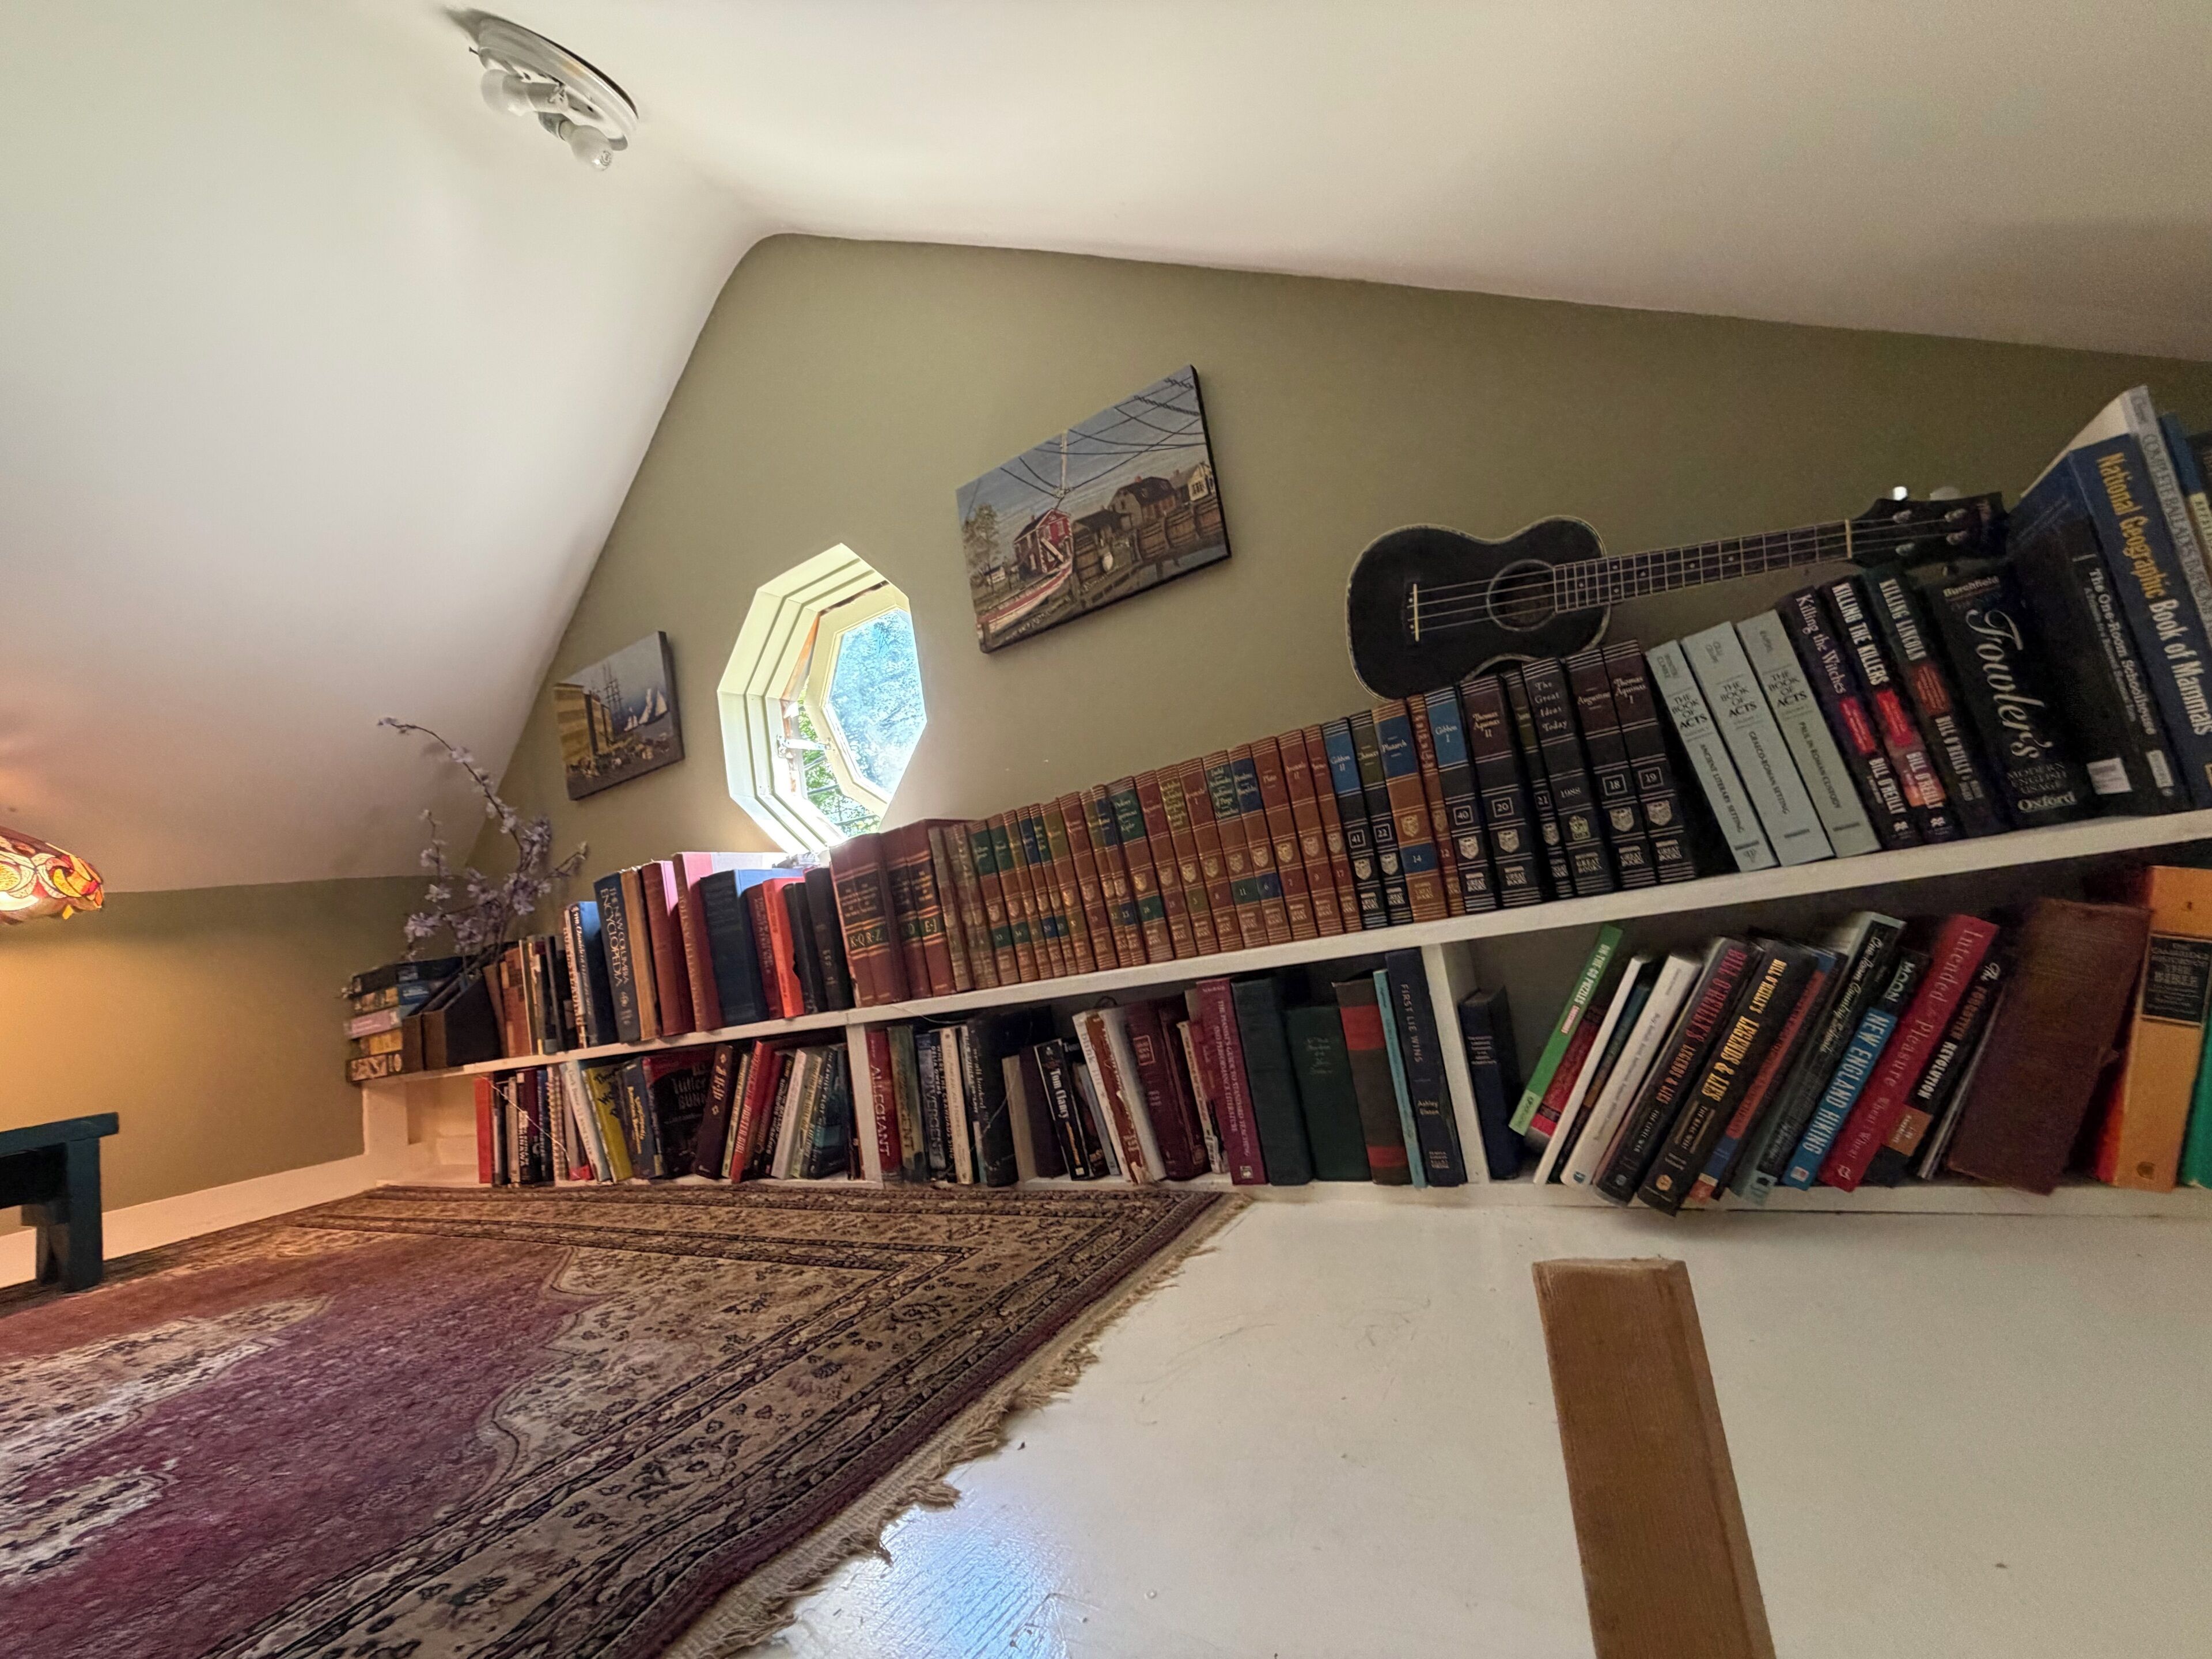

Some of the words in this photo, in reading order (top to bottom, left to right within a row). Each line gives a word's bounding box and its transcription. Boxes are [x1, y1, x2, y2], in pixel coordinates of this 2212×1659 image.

[2098, 452, 2143, 516] National
[2119, 515, 2171, 599] Geographic
[1833, 583, 1862, 623] KILLING
[1880, 578, 1908, 619] KILLING
[1896, 620, 1926, 660] LINCOLN
[2149, 599, 2189, 641] Book
[1849, 622, 1872, 644] THE
[1796, 594, 1819, 634] Killing
[1813, 634, 1829, 652] the
[1823, 650, 1845, 694] Witches
[2090, 568, 2104, 592] The
[2098, 593, 2127, 657] One-Room
[2122, 660, 2156, 734] Schoolhouse
[2164, 643, 2198, 660] of
[1858, 644, 1888, 685] KILLERS
[1534, 681, 1552, 691] The
[1613, 675, 1643, 687] Thomas
[1768, 677, 1800, 691] BOOK
[1771, 671, 1789, 681] THE
[1965, 608, 2054, 759] Fowler's
[1615, 684, 1646, 697] Aquinas
[1720, 688, 1749, 702] BOOK
[1723, 682, 1740, 691] THE
[1780, 686, 1793, 696] OF
[1535, 692, 1560, 704] Great
[1578, 692, 1611, 704] Augustine
[1671, 699, 1699, 714] BOOK
[1674, 694, 1690, 704] THE
[1732, 697, 1743, 706] OF
[1778, 691, 1807, 706] ACTS
[2170, 660, 2212, 736] Mammals
[1472, 711, 1498, 721] Thomas
[1540, 706, 1562, 717] Ideas
[1682, 710, 1694, 718] OF
[1729, 703, 1757, 716] ACTS
[1435, 725, 1457, 735] Gibbon
[1474, 719, 1500, 730] Aquinas
[1541, 720, 1567, 732] Today
[1680, 715, 1707, 729] ACTS
[1485, 729, 1492, 738] II
[1381, 741, 1407, 753] Plutarch
[1331, 755, 1350, 764] Gibbon
[1339, 763, 1345, 771] II
[1800, 721, 1810, 738] PAUL
[1806, 740, 1813, 748] IN
[1810, 749, 1825, 775] ROMAN
[1822, 776, 1840, 808] CUSTODY
[1869, 757, 1888, 778] BILL
[1645, 773, 1657, 782] 19
[1749, 731, 1776, 786] GRAECO-ROMAN
[1773, 786, 1789, 815] SETTING
[1906, 752, 1924, 772] BILL
[1916, 772, 1942, 808] O'REILLY
[1560, 787, 1581, 798] 1988
[1609, 781, 1620, 789] 18
[1700, 744, 1718, 772] ANCIENT
[1713, 774, 1730, 802] LITERARY
[1728, 804, 1744, 833] SETTING
[1537, 796, 1548, 805] 21
[1878, 778, 1905, 814] O'REILLY
[2018, 789, 2075, 813] Oxford
[1457, 810, 1469, 819] 40
[1497, 802, 1509, 812] 20
[1351, 834, 1361, 843] 41
[1378, 828, 1388, 838] 22
[1412, 855, 1422, 863] 14
[1576, 857, 1599, 866] GREAT
[1578, 864, 1602, 873] BOOKS
[1336, 869, 1344, 878] 17
[609, 887, 618, 903] THE
[1239, 888, 1246, 896] 11
[615, 906, 623, 930] NEW
[602, 888, 622, 986] ENCYCLOPEDIA
[1865, 936, 1883, 955] One
[616, 931, 628, 984] COLUMBIA
[1718, 948, 1747, 976] BILL
[1767, 959, 1787, 976] BILL
[1929, 929, 1983, 1002] Intended
[1853, 957, 1873, 981] Room
[1980, 962, 2000, 980] The
[1574, 977, 1593, 1005] PUZZLES
[1884, 961, 1915, 1002] MOON
[1402, 984, 1413, 1012] FIRST
[1749, 975, 1777, 1013] O'REILLY'S
[1834, 982, 1861, 1019] Country
[1685, 977, 1730, 1041] O'REILLY'S
[1952, 986, 1987, 1040] FORGOTTEN
[1221, 1014, 1231, 1046] PIANIST'S
[1407, 1016, 1417, 1031] LIE
[1859, 1013, 1889, 1047] NEW
[1721, 1016, 1759, 1065] LEGENDS
[1820, 1020, 1843, 1053] Schools
[1226, 1047, 1235, 1069] GUIDE
[1411, 1036, 1423, 1062] WINS
[1885, 1020, 1934, 1087] Pleasure
[1669, 1044, 1694, 1078] LEGENDS
[1713, 1062, 1734, 1075] &
[1918, 1041, 1957, 1099] REVOLUTION
[823, 1063, 832, 1091] FAMILY
[1230, 1070, 1237, 1081] TO
[1826, 1047, 1872, 1108] ENGLAND
[937, 1045, 945, 1072] WHERE
[942, 1093, 952, 1137] CRAWDADS
[976, 1077, 985, 1108] looked
[1050, 1068, 1062, 1089] Tom
[1056, 1089, 1069, 1118] Clancy
[1217, 1041, 1230, 1090] PERFORMANCE
[1225, 1092, 1237, 1132] LITERATURE
[1656, 1085, 1674, 1104] LIES
[1702, 1073, 1729, 1101] LIES
[871, 1065, 889, 1156] ALLEGIANT
[1232, 1082, 1244, 1119] STANDARD
[1418, 1099, 1438, 1109] Ashley
[1868, 1097, 1889, 1124] Wheat
[740, 1104, 751, 1134] POSTER
[923, 1074, 944, 1158] DIVERGENT
[1650, 1109, 1659, 1122] THE
[1697, 1106, 1707, 1118] THE
[1240, 1120, 1250, 1157] TEACHING
[1641, 1122, 1653, 1138] CIVIL
[1803, 1108, 1839, 1154] HIKING
[735, 1135, 745, 1153] GIRL
[1634, 1139, 1644, 1152] WAR
[1681, 1135, 1692, 1150] WEST
[1849, 1132, 1871, 1159] Wheat
